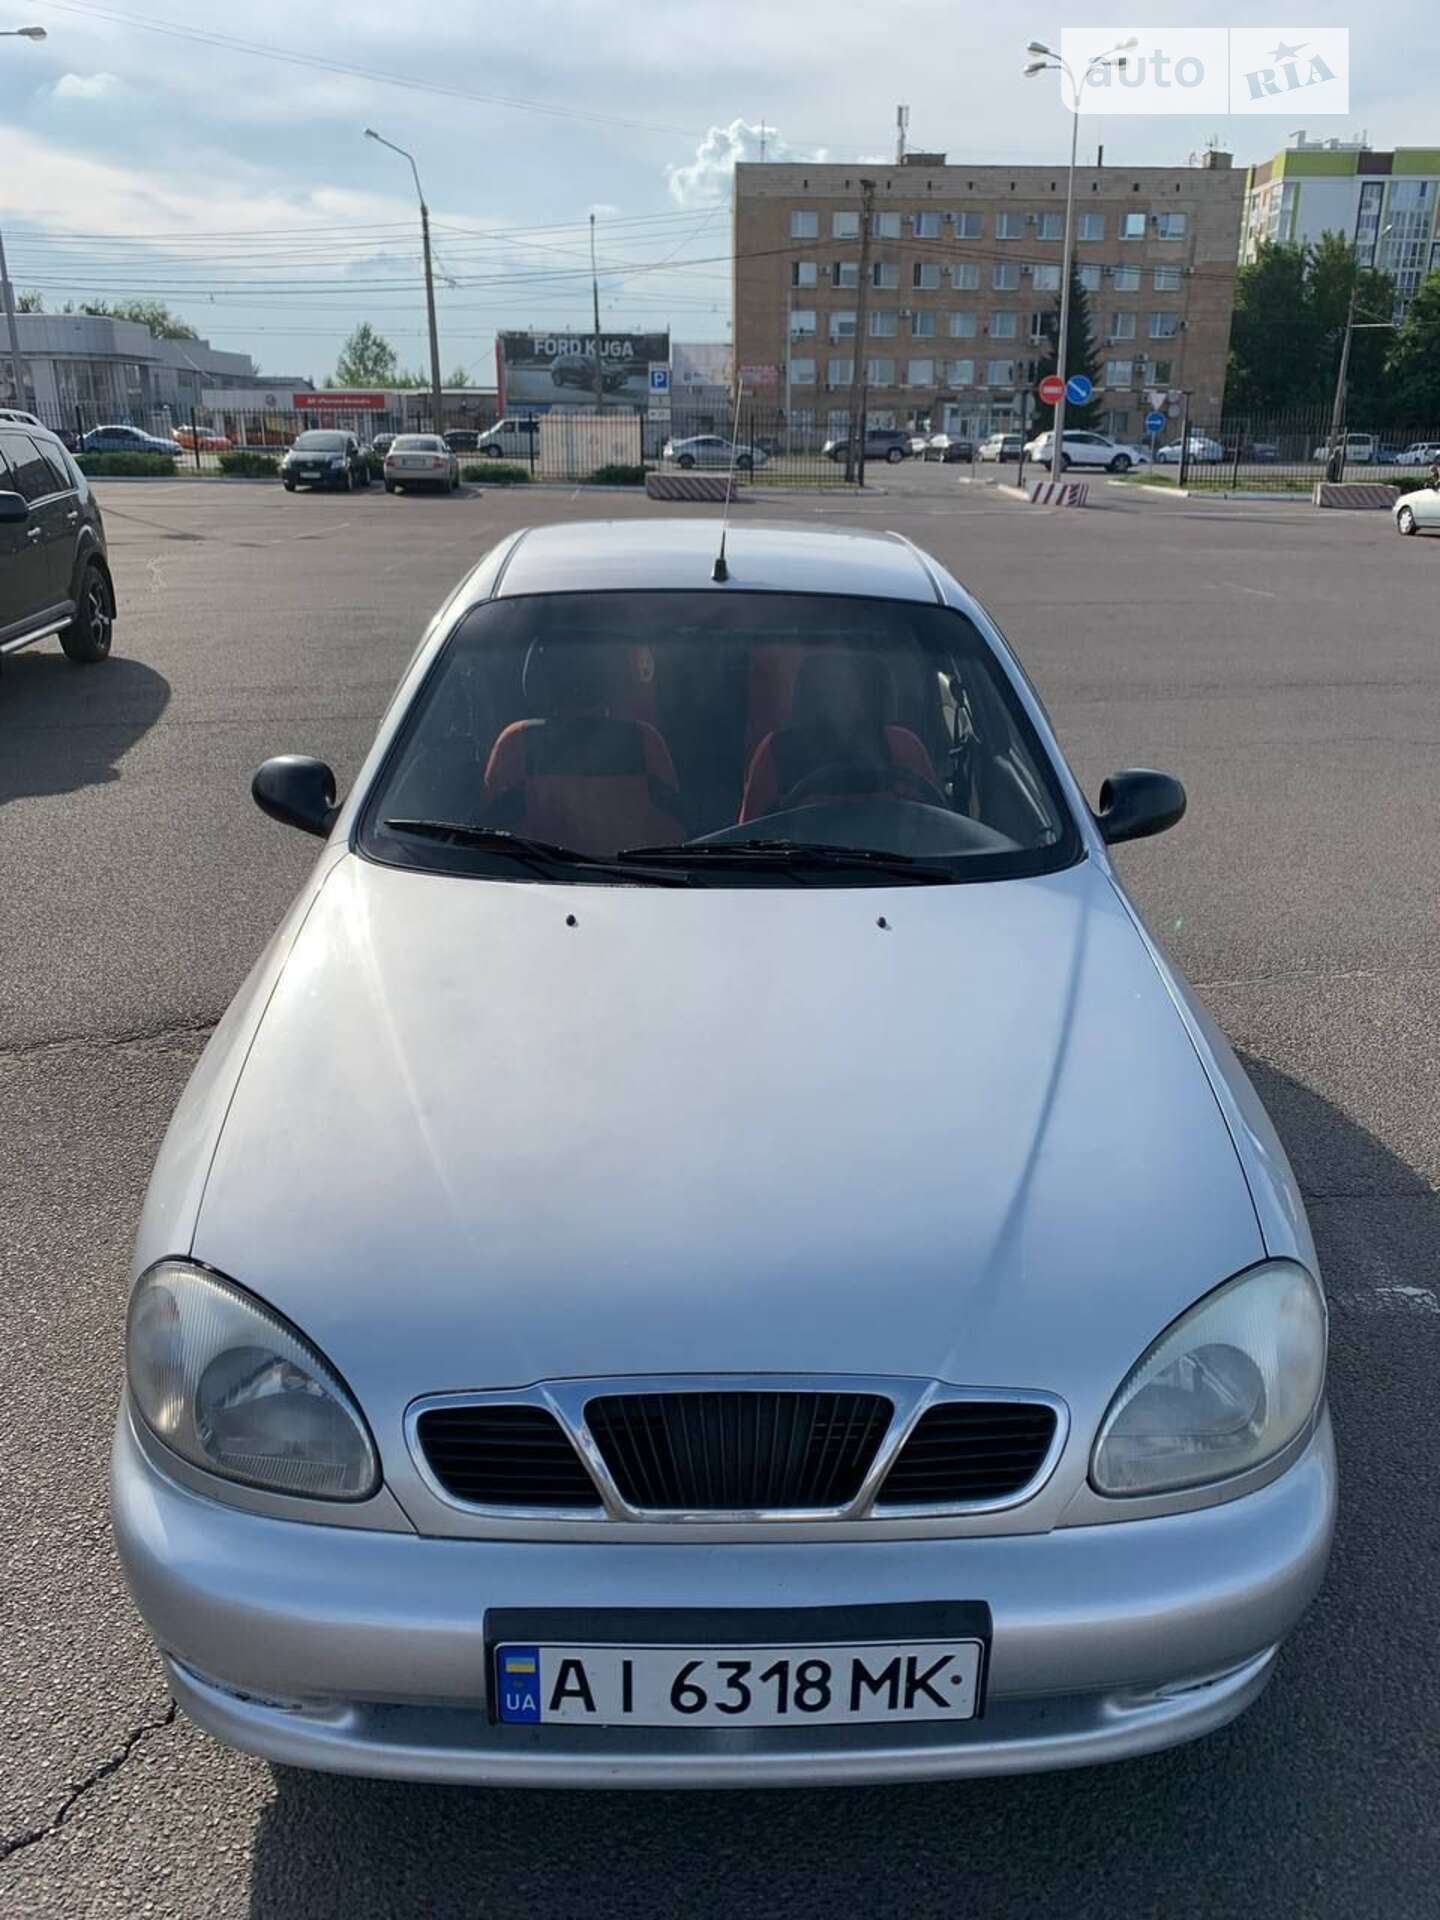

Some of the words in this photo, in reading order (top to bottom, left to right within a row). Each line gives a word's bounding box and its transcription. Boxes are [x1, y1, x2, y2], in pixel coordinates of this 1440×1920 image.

[533, 338, 580, 356] FORD
[584, 338, 634, 357] KUGA
[654, 372, 665, 387] P
[670, 1659, 832, 1715] 6318
[850, 1654, 956, 1712] MK
[506, 1693, 536, 1711] UA
